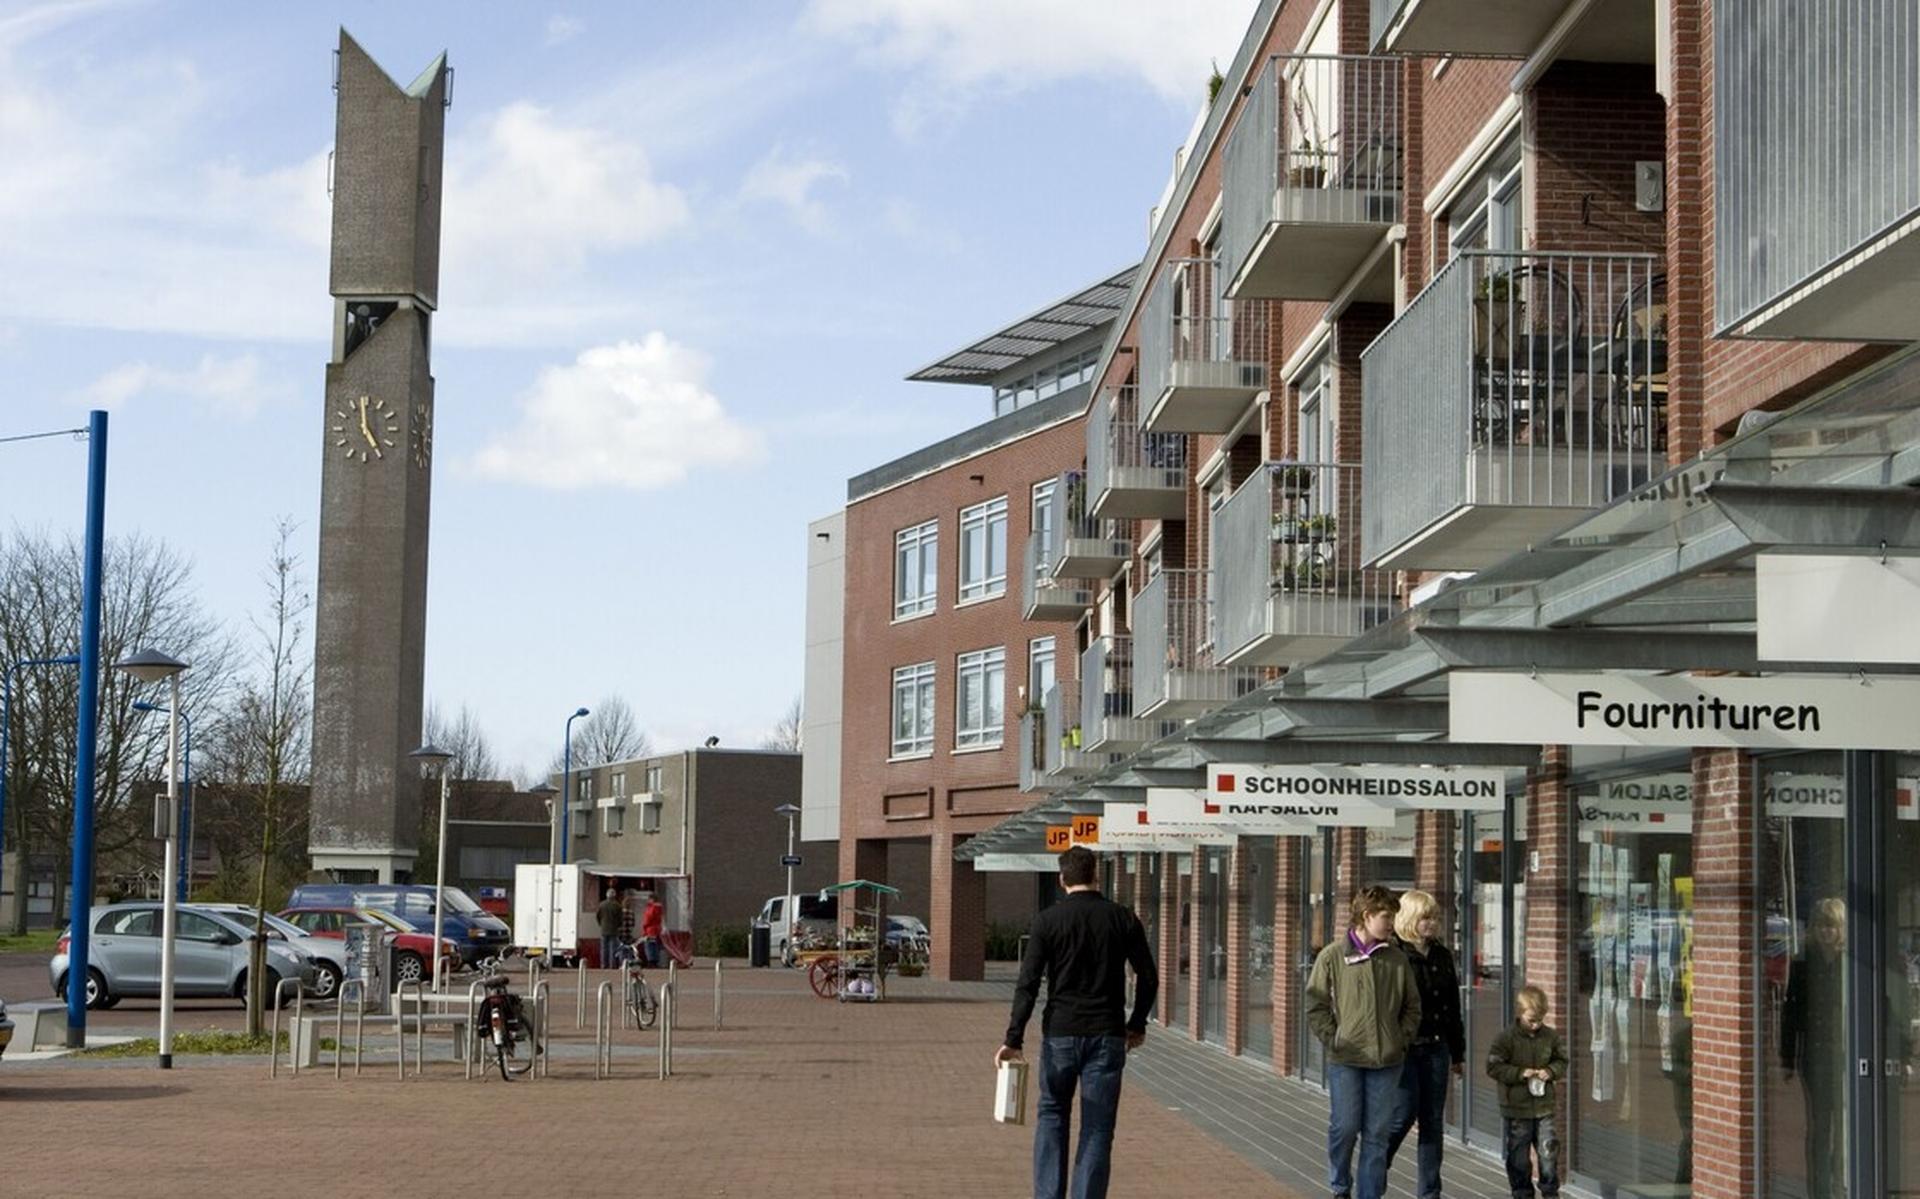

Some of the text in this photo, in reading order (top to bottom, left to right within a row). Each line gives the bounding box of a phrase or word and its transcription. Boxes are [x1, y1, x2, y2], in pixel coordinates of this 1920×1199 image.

[1577, 691, 1821, 732] Fournituren
[1244, 776, 1497, 797] SCHOONHEIDSSALON
[1048, 831, 1069, 845] JP
[1074, 822, 1097, 837] JP
